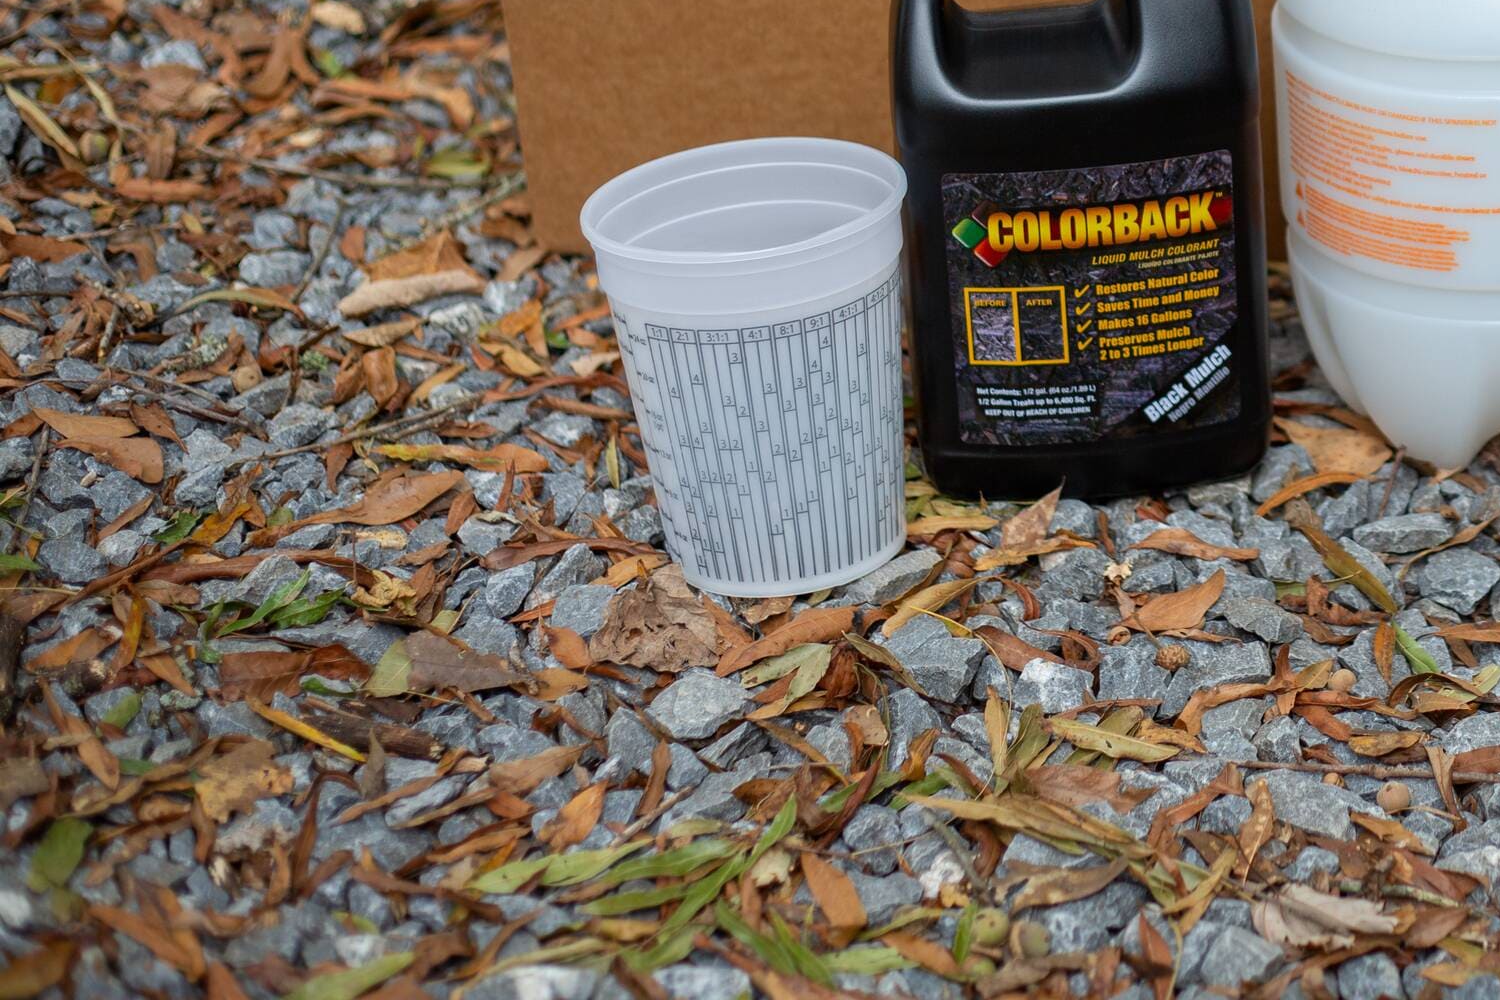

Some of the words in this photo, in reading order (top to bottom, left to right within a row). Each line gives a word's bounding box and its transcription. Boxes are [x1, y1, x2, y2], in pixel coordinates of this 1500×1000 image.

[988, 191, 1217, 253] COLORBACK
[1092, 253, 1126, 265] LIQUID
[1128, 247, 1165, 261] MULCH
[1167, 238, 1220, 256] COLORANT
[1096, 280, 1146, 296] Restores
[1147, 273, 1188, 289] Natural
[1190, 268, 1219, 283] Color
[974, 299, 1006, 307] BEFORE
[1025, 298, 1053, 306] AFTER
[1097, 300, 1130, 313] Saves
[1132, 296, 1159, 309] Time
[1162, 292, 1182, 305] and
[1184, 285, 1220, 301] Money
[839, 303, 858, 318] 4:1:1
[810, 317, 824, 329] 9:1
[1098, 317, 1134, 330] Makes
[1136, 314, 1149, 325] 16
[1150, 308, 1192, 324] Gallons
[651, 327, 663, 338] 1:1
[748, 329, 762, 339] 4:1
[780, 324, 794, 335] 8:1
[676, 331, 689, 341] 2:1
[706, 332, 729, 342] 3:1:1
[823, 336, 829, 345] 4
[1099, 332, 1155, 348] Preserves
[1156, 325, 1190, 340] Mulch
[860, 343, 865, 353] 3
[1100, 349, 1107, 361] 2
[1109, 348, 1120, 359] to
[1123, 347, 1130, 358] 3
[1132, 342, 1165, 357] Times
[1167, 336, 1205, 352] Longer
[731, 353, 738, 362] 3
[811, 360, 818, 369] 4
[693, 374, 699, 382] 4
[825, 372, 831, 381] 3
[797, 378, 803, 386] 3
[851, 380, 857, 390] 3
[1143, 382, 1190, 423] Black
[1184, 344, 1232, 388] Mulch
[671, 387, 677, 395] 4
[766, 383, 772, 392] 3
[990, 388, 1022, 396] Contents:
[725, 396, 732, 404] 3
[815, 393, 821, 402] 3
[862, 393, 867, 402] 2
[990, 398, 1012, 406] Gallon
[786, 400, 792, 409] 3
[740, 406, 746, 415] 2
[829, 408, 834, 417] 2
[1026, 408, 1047, 416] REACH
[1059, 406, 1091, 414] CHILDREN
[1167, 396, 1196, 423] Negro
[702, 422, 708, 431] 3
[760, 421, 765, 429] 3
[844, 419, 849, 428] 3
[855, 421, 860, 431] 2
[818, 427, 823, 436] 2
[803, 433, 808, 442] 2
[720, 440, 727, 448] 3
[733, 440, 739, 448] 2
[775, 444, 781, 453] 2
[865, 443, 869, 452] 1
[792, 450, 798, 458] 2
[833, 446, 837, 454] 1
[847, 452, 851, 461] 2
[822, 461, 826, 469] 1
[858, 465, 862, 474] 1
[701, 471, 707, 479] 3
[712, 472, 717, 481] 2
[727, 473, 733, 482] 2
[766, 471, 772, 480] 2
[692, 487, 697, 495] 2
[741, 485, 746, 493] 1
[849, 487, 853, 497] 1
[810, 490, 815, 499] 1
[708, 505, 713, 514] 2
[799, 502, 804, 510] 1
[734, 508, 738, 516] 1
[784, 509, 789, 517] 1
[692, 529, 698, 537] 2
[775, 524, 779, 533] 1
[703, 539, 707, 547] 1
[716, 542, 720, 550] 1
